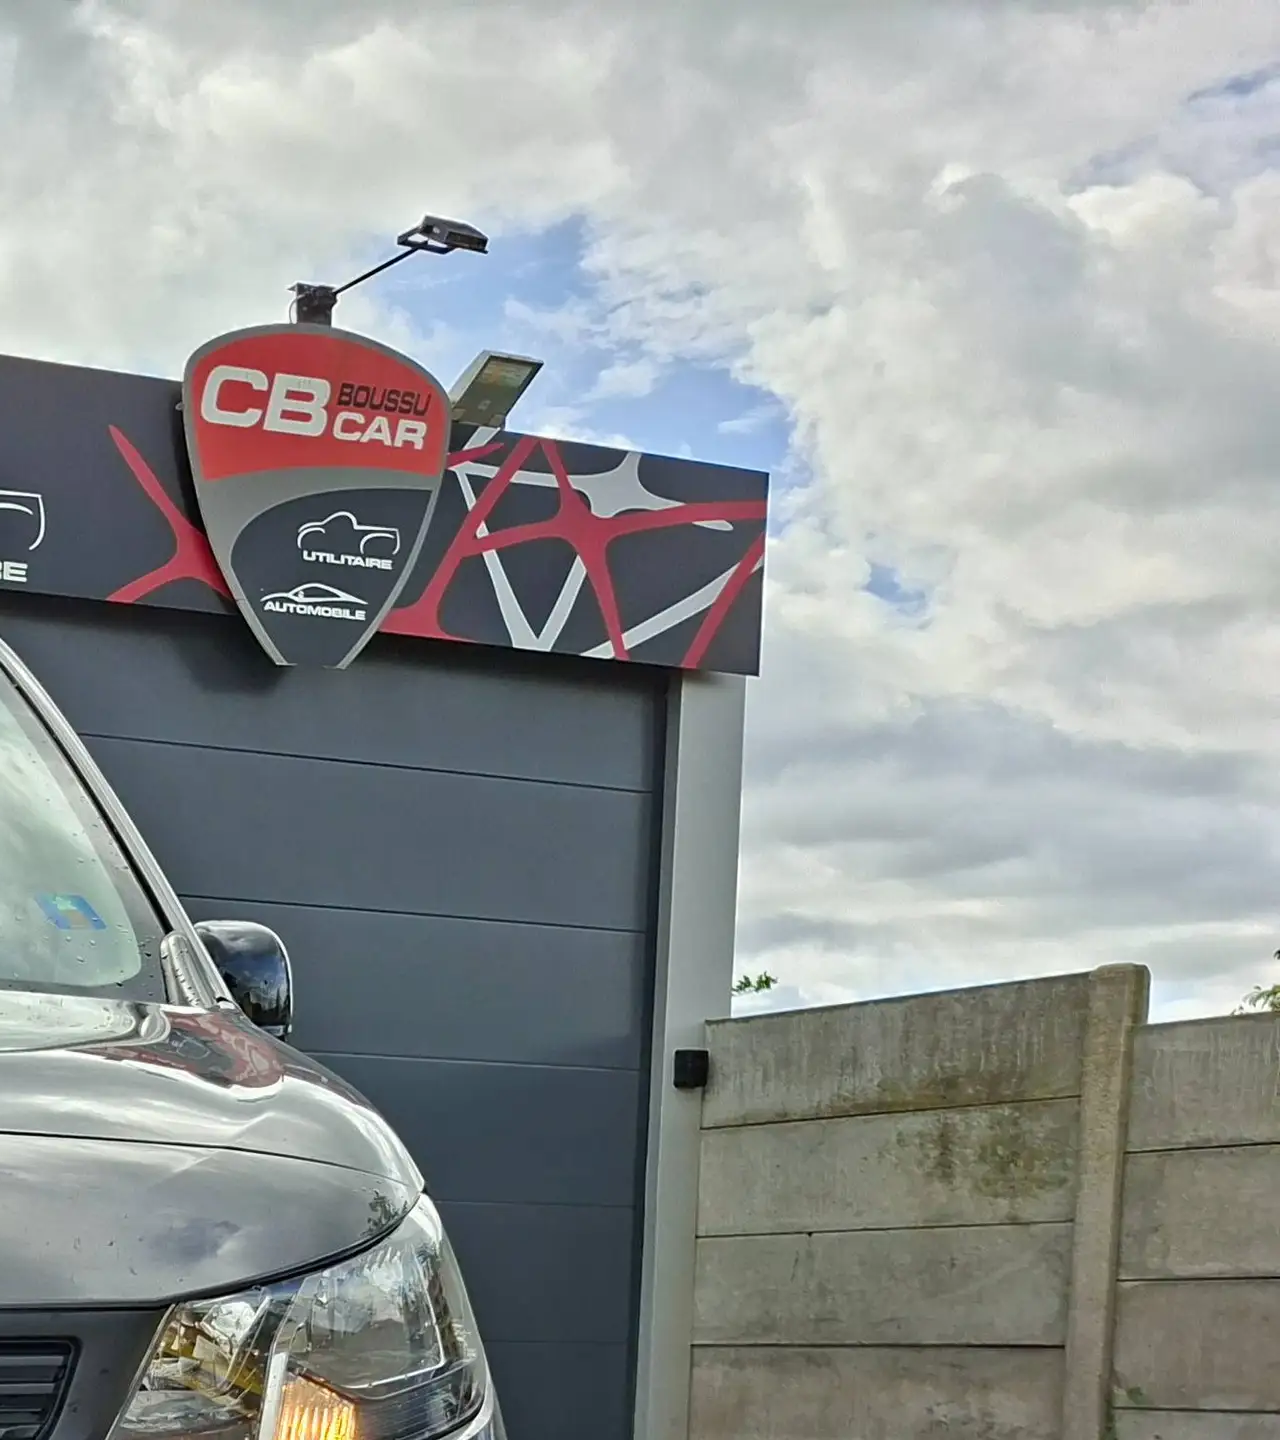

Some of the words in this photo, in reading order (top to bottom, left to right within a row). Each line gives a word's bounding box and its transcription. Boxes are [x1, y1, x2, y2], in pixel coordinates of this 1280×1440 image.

[200, 364, 332, 437] CB
[332, 411, 428, 450] CAR
[336, 382, 432, 417] BOUSSU
[302, 549, 393, 571] UTILITAIRE
[263, 600, 367, 621] AUTOMOBILE
